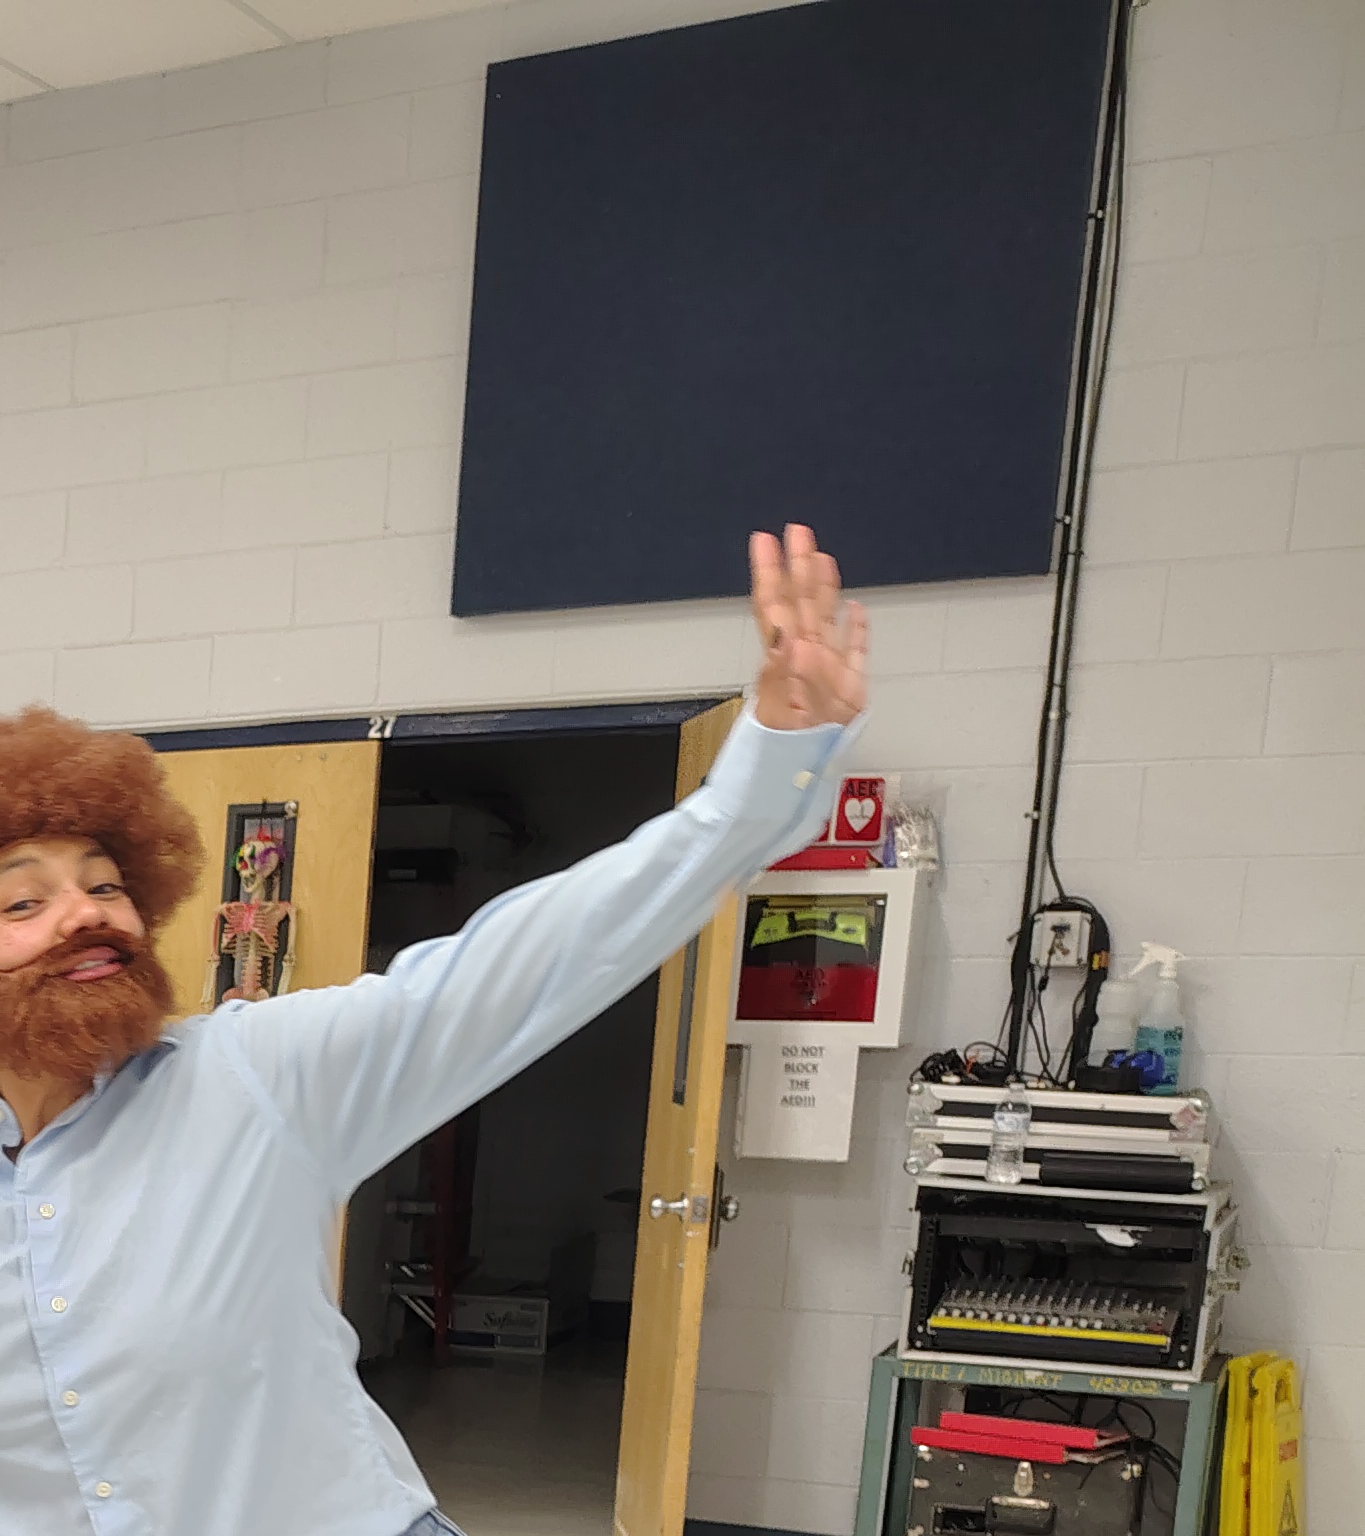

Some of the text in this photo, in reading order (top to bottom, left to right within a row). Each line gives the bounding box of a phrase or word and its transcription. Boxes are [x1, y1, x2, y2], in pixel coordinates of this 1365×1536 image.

[781, 1045, 825, 1057] DO NOT
[784, 1062, 819, 1073] BLOCK
[789, 1078, 810, 1090] THE
[903, 1361, 949, 1379] TITLE
